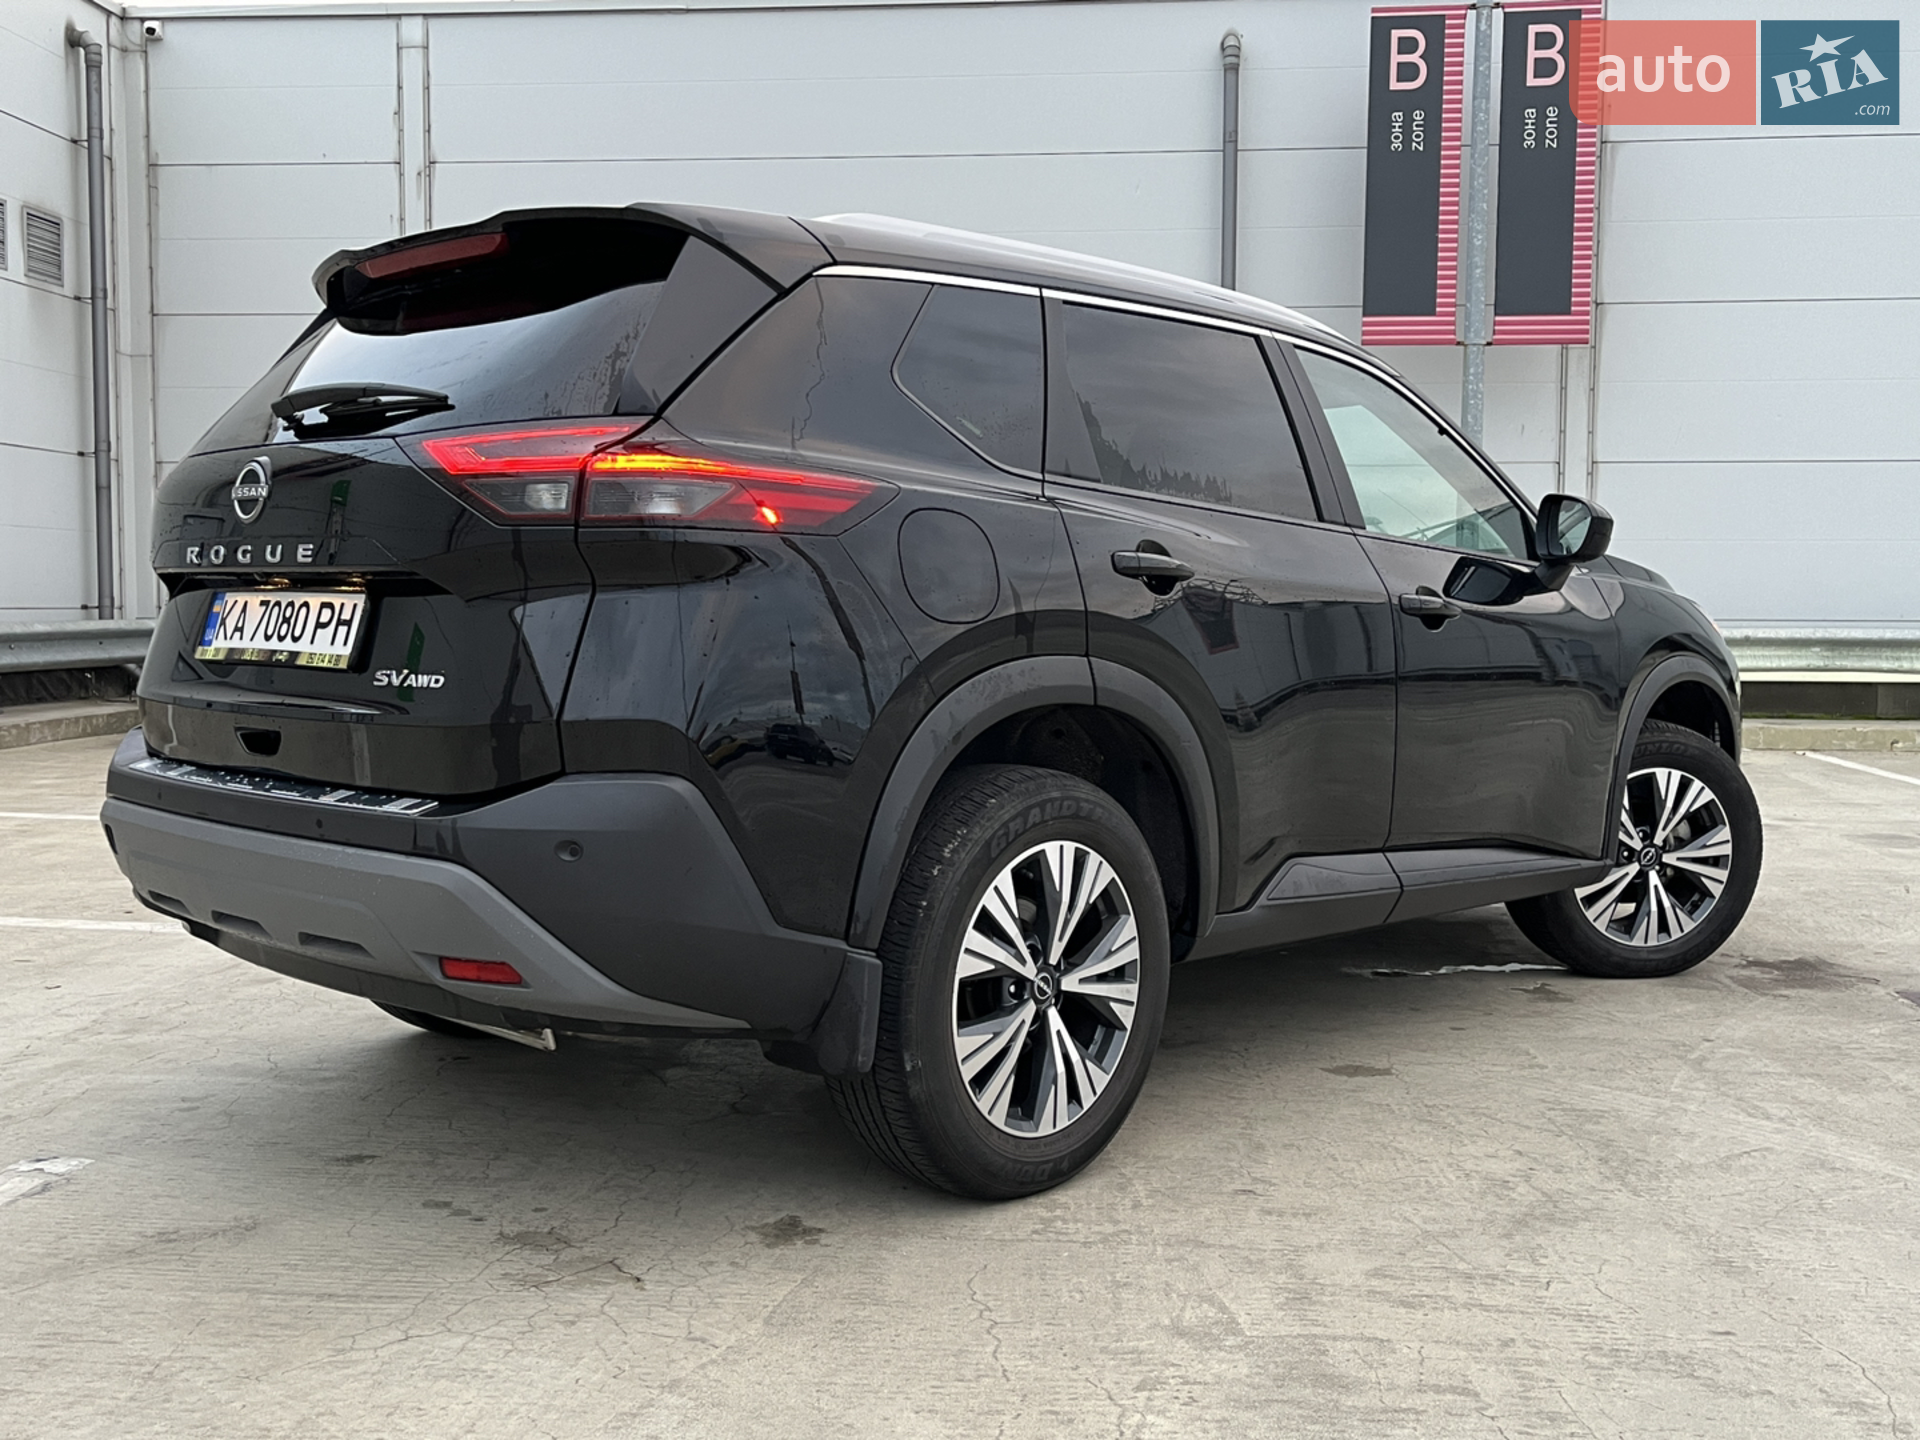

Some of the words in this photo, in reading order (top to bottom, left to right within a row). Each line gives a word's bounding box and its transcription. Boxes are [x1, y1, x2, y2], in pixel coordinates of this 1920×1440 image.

[1389, 28, 1428, 90] B
[1526, 23, 1566, 87] B
[1390, 110, 1404, 151] зона
[1411, 109, 1425, 151] zone
[1523, 107, 1537, 149] зона
[1545, 106, 1559, 149] zone
[232, 485, 268, 499] SSAN
[185, 543, 315, 565] ROGUE
[215, 599, 248, 641] KA
[250, 599, 311, 643] 7080
[310, 601, 358, 647] PH
[373, 668, 409, 686] SV
[403, 674, 445, 688] AWD
[1634, 742, 1700, 757] UNLOP
